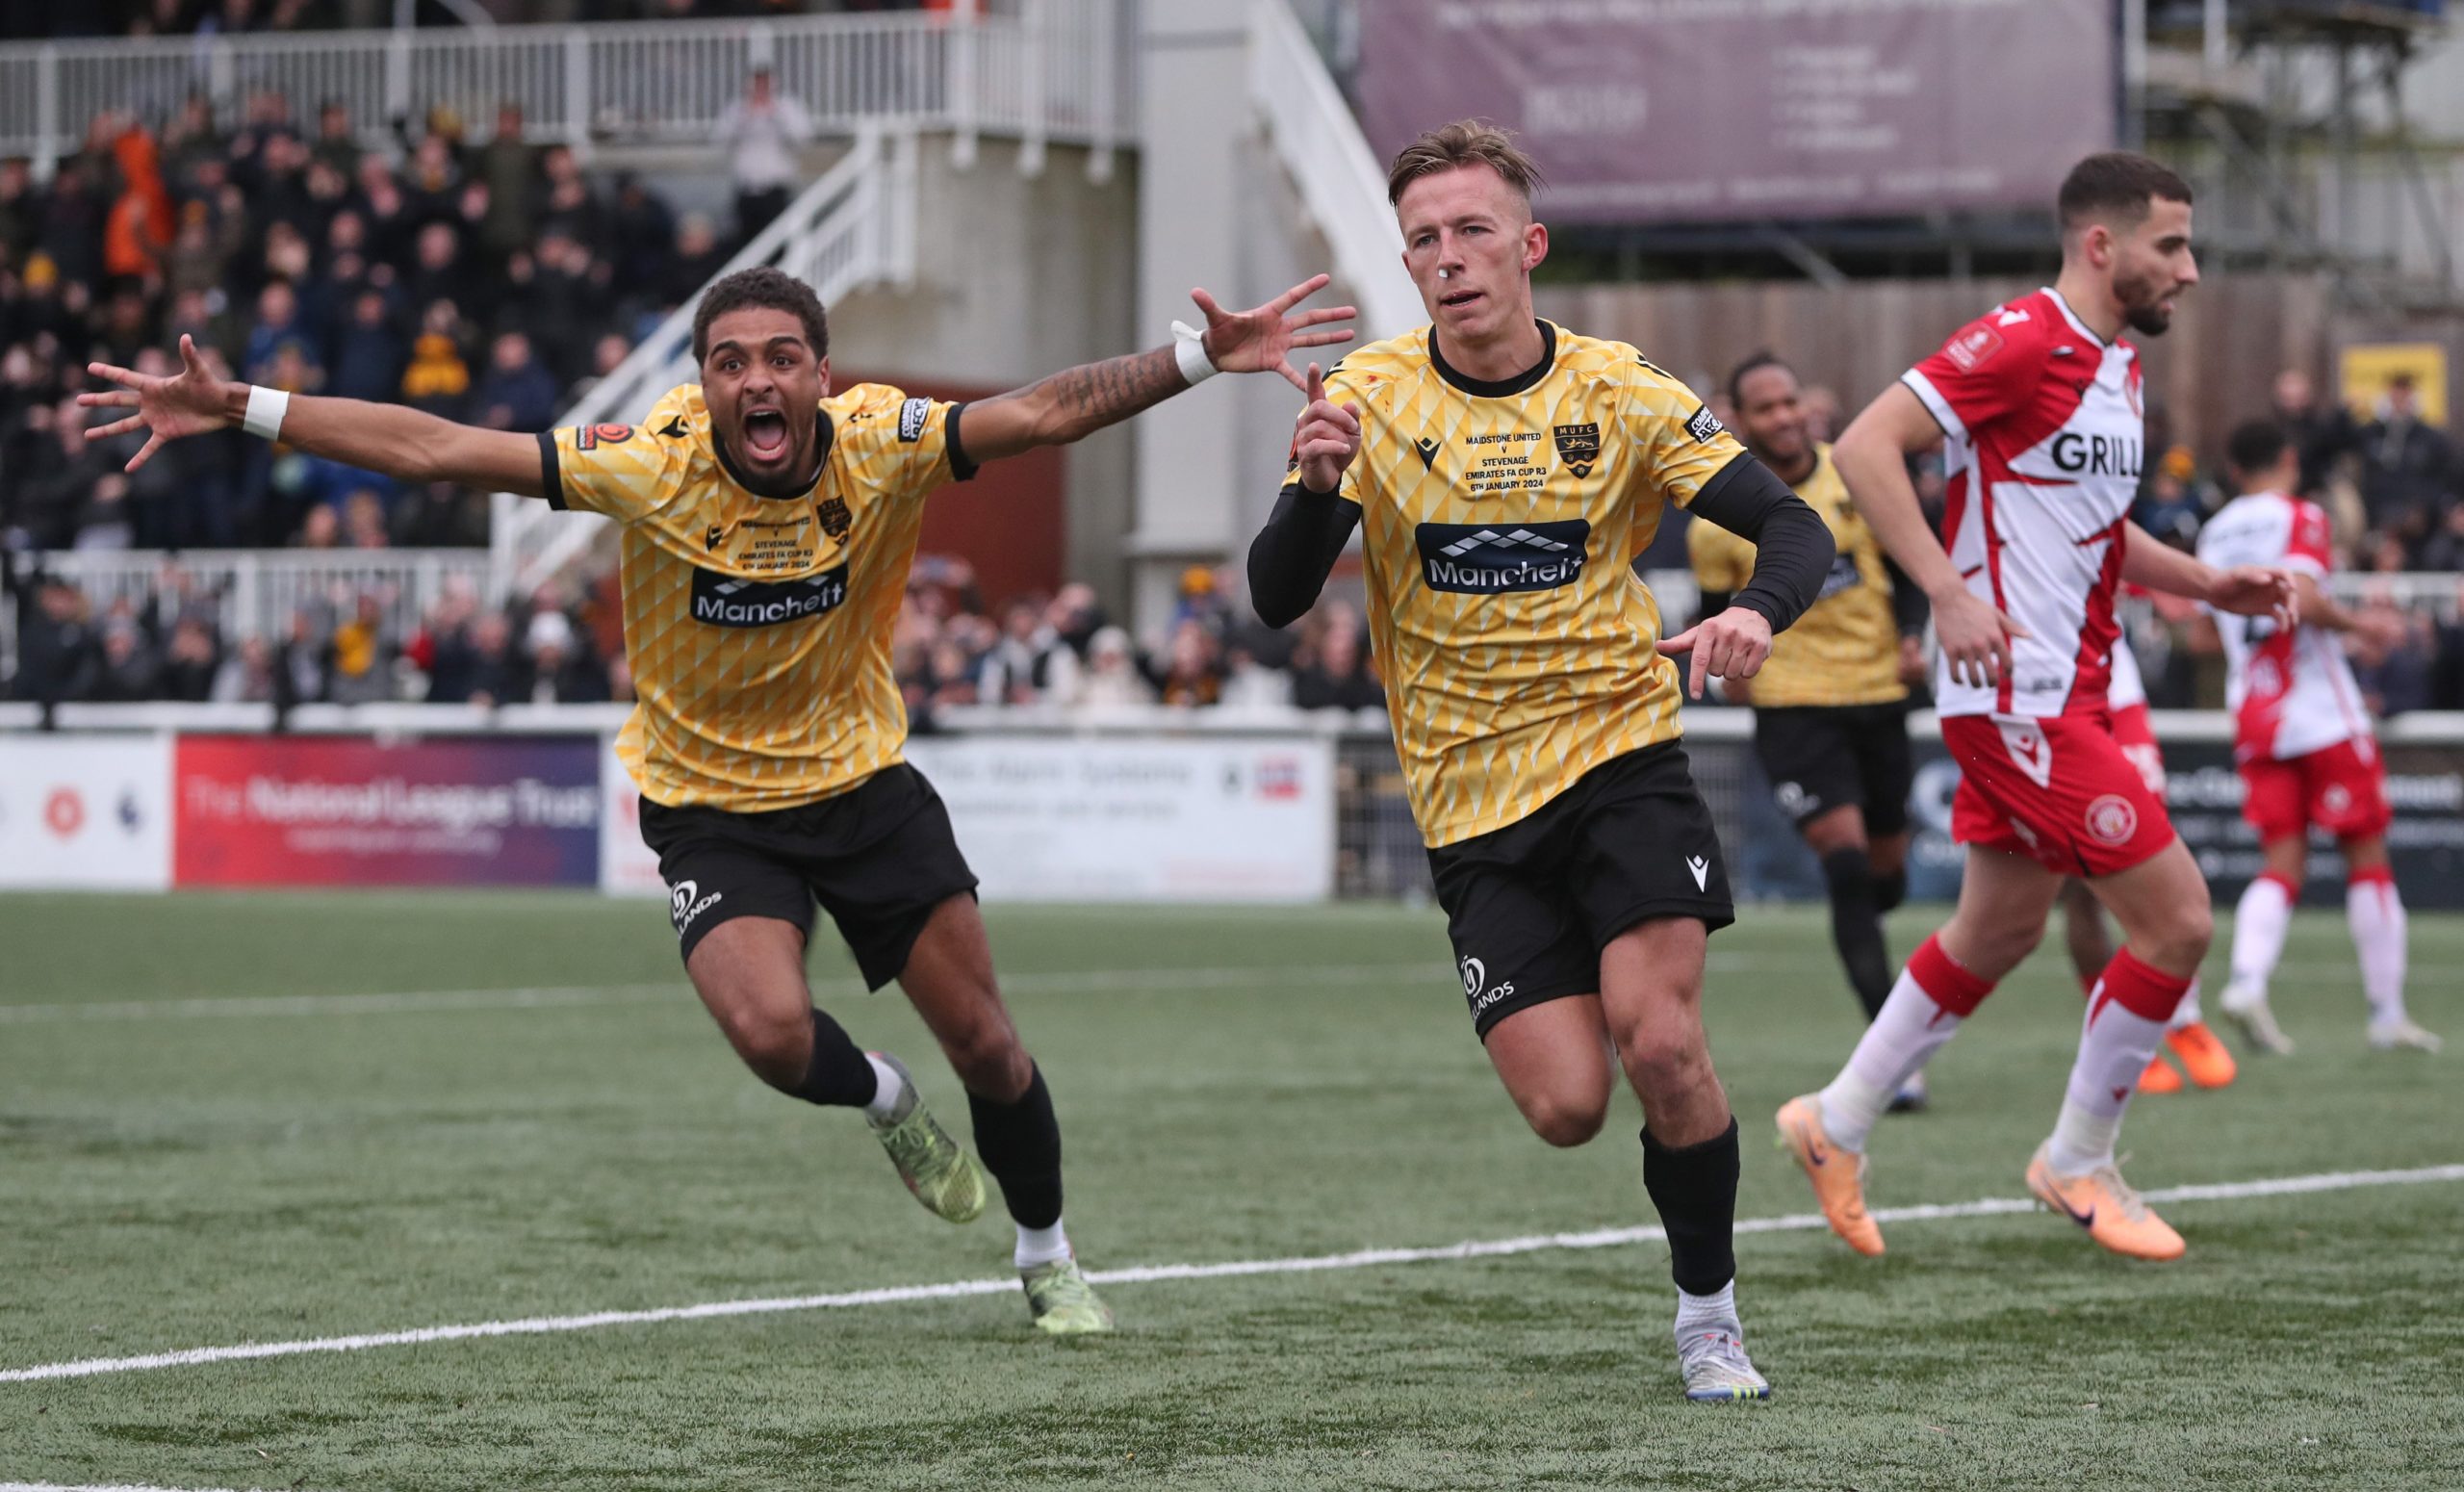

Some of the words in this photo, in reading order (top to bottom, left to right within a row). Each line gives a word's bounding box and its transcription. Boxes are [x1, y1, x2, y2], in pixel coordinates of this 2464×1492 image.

[1559, 425, 1593, 435] MUFC
[1466, 434, 1512, 445] MAIDSTONE
[1513, 432, 1542, 442] UNITED
[1481, 456, 1528, 467] STEVENAGE
[1465, 469, 1505, 480] EMIRATES
[1506, 469, 1517, 477] FA
[1518, 468, 1535, 477] CUP
[1536, 467, 1547, 476] R3
[1485, 480, 1521, 491] JANUARY
[1523, 479, 1544, 488] 2024
[755, 539, 798, 549] STEVENAGE
[738, 551, 776, 560] EMIRATES
[787, 550, 802, 558] CUP
[697, 582, 842, 622] Manchett
